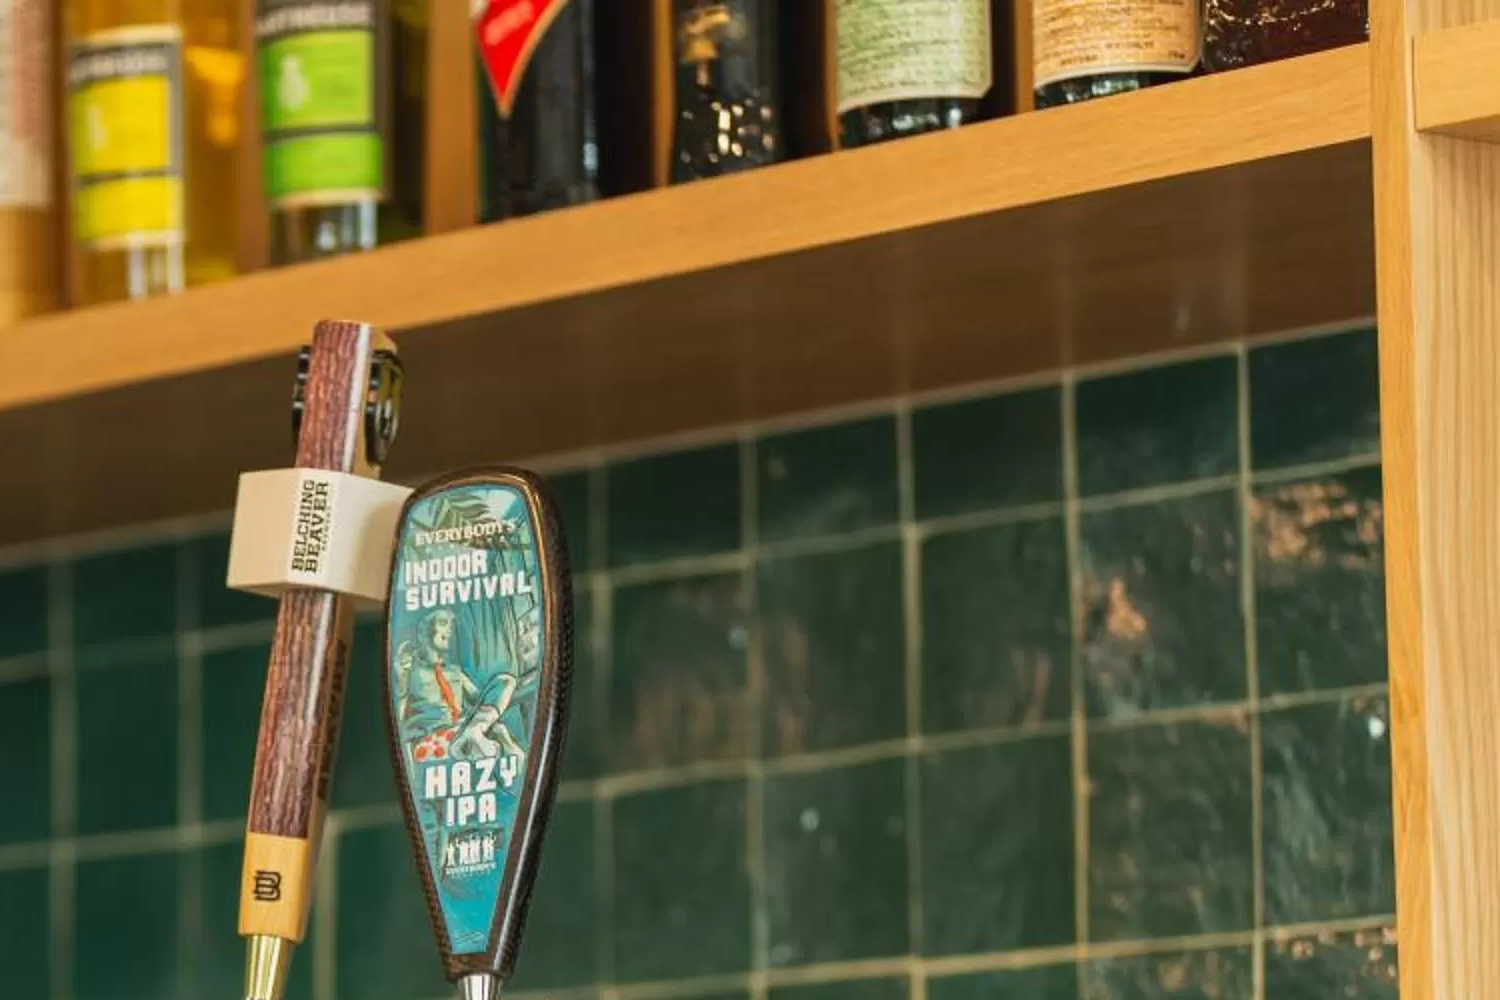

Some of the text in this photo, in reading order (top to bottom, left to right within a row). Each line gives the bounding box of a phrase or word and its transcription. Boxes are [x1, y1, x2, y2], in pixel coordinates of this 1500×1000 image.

[292, 479, 315, 571] BELCHING
[304, 480, 329, 573] BEAVER
[405, 549, 487, 585] INDOOR
[405, 570, 533, 611] SURVIVAL
[424, 756, 517, 799] HAZY
[446, 792, 497, 826] IPA
